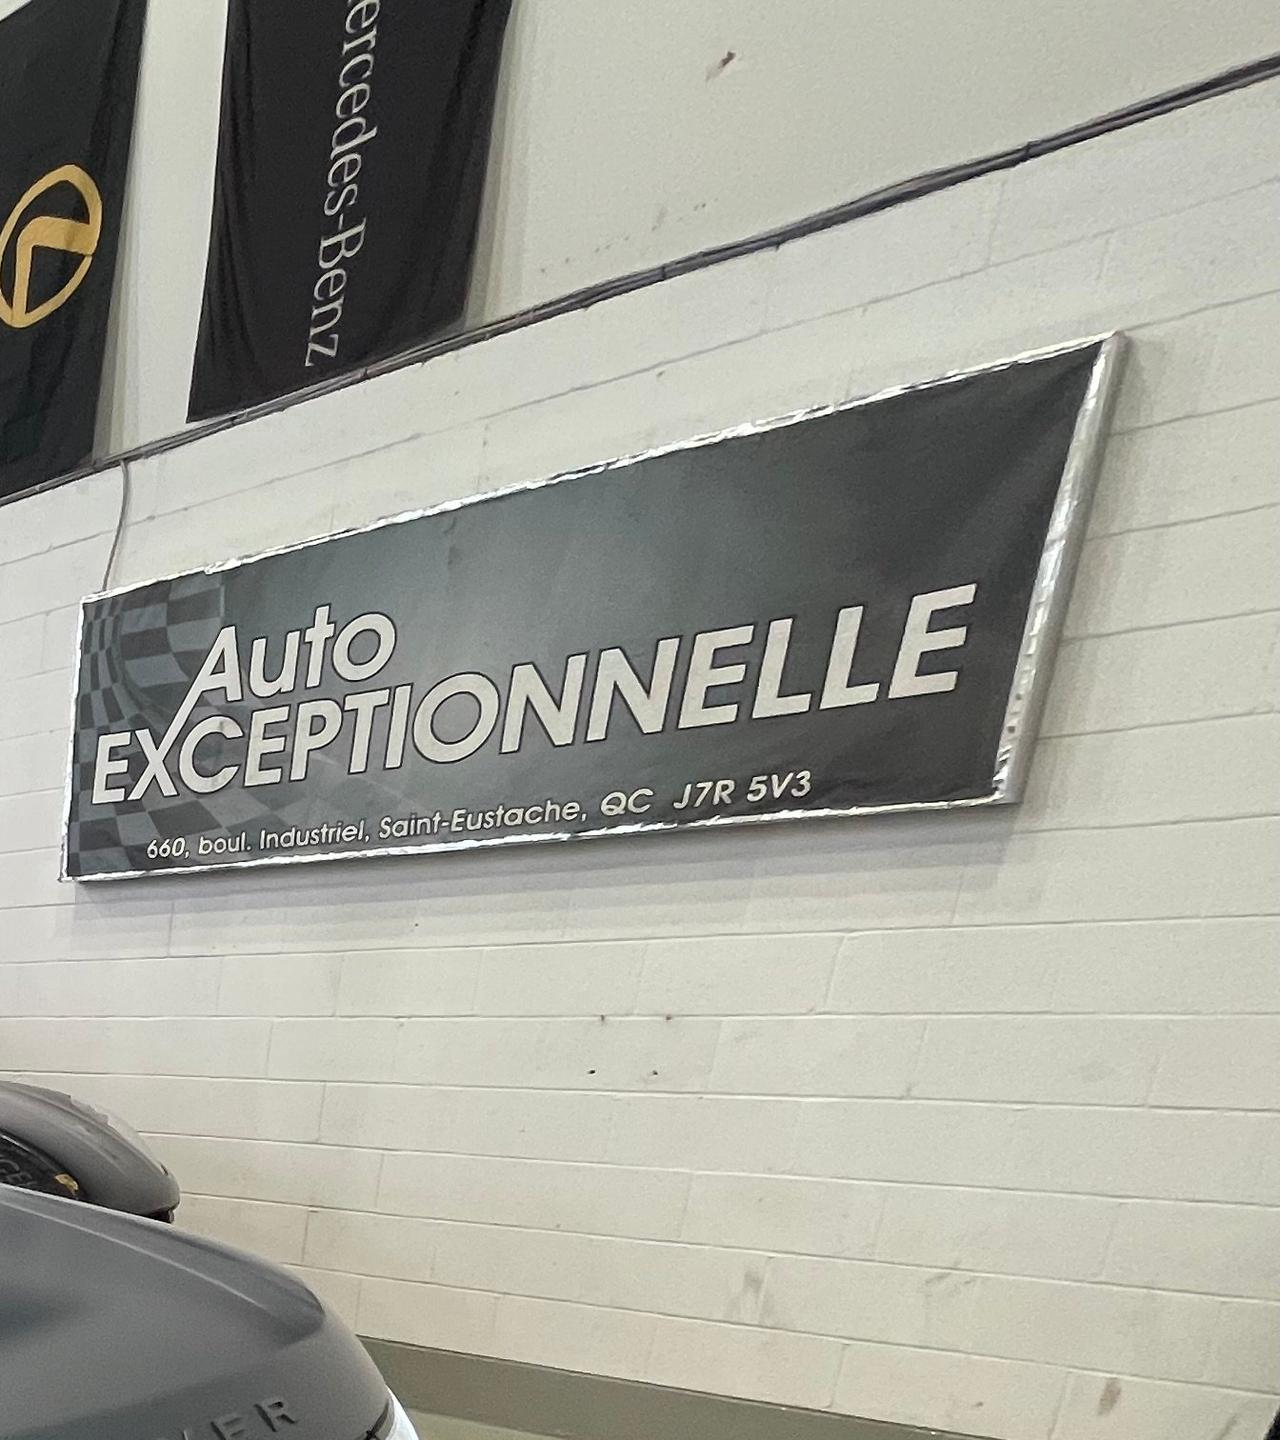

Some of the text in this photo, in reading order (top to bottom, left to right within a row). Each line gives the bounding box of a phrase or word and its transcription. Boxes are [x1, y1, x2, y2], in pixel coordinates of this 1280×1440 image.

[303, 0, 380, 367] ercedes-Benz
[91, 583, 979, 807] EXCEPTIONNELLE
[184, 603, 398, 710] Auto
[146, 769, 813, 860] 660, boul. Industriel, Saint-Eustache, QC J7R 5V3
